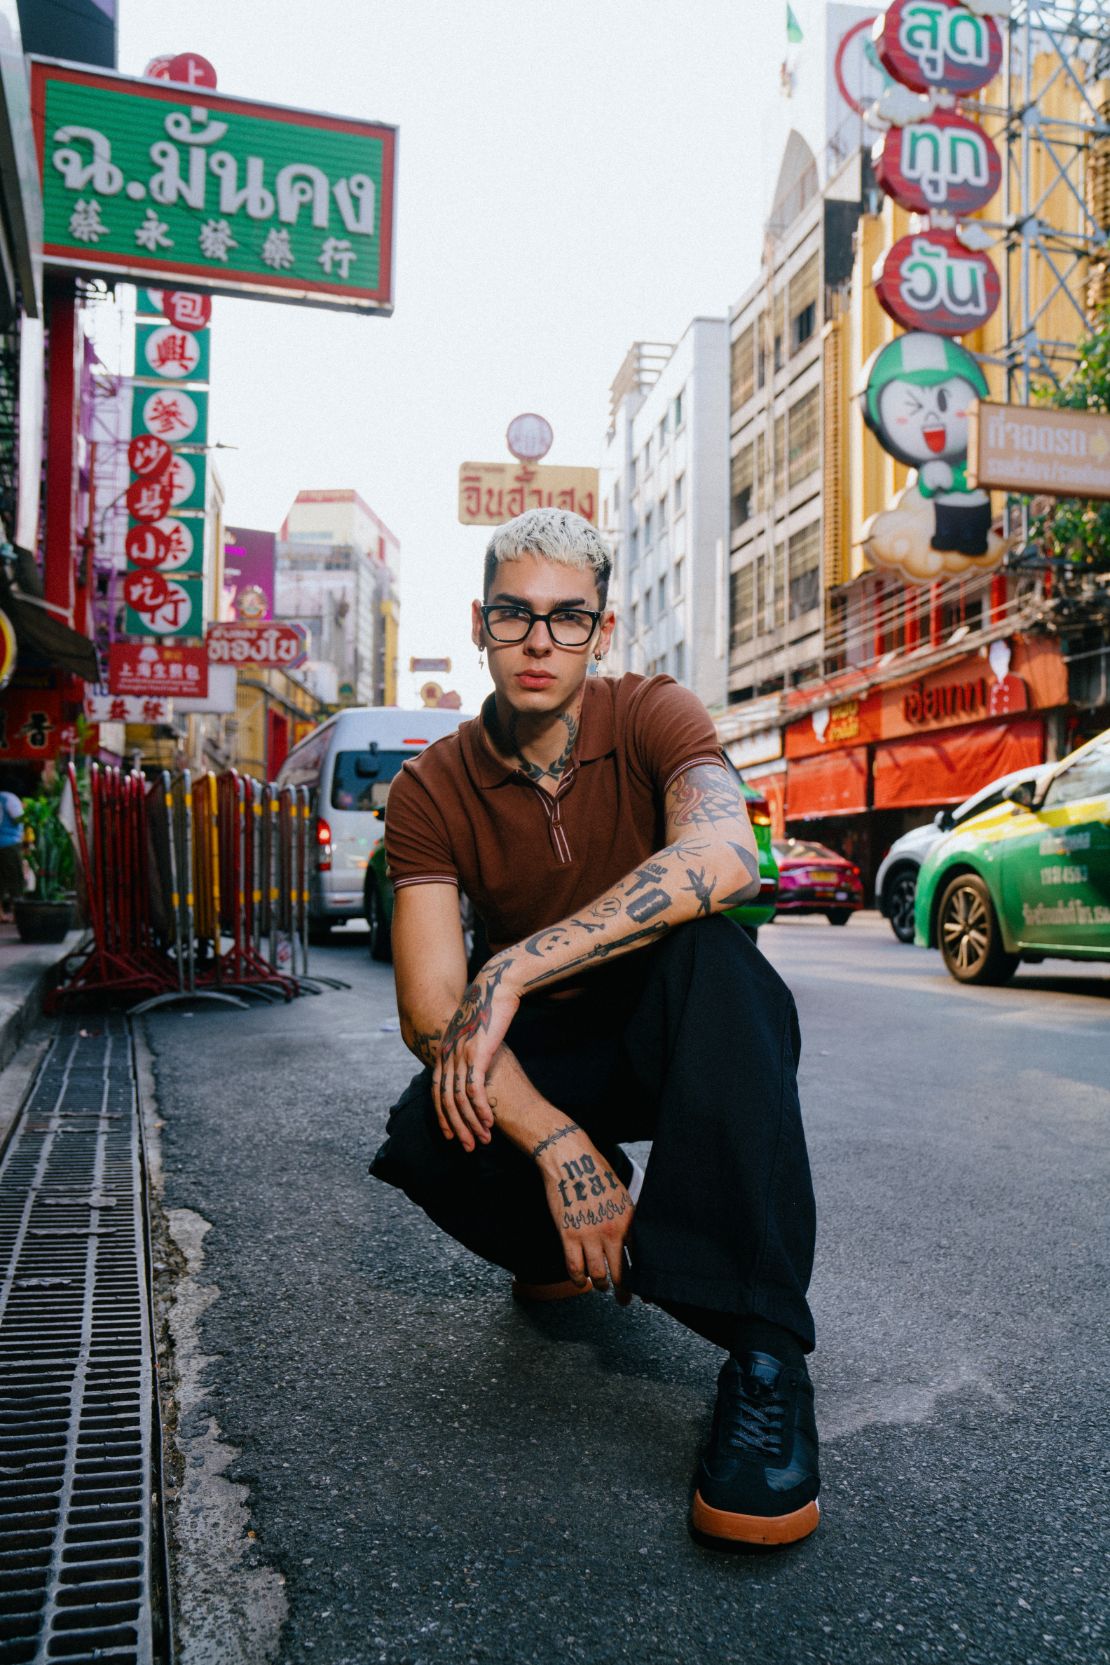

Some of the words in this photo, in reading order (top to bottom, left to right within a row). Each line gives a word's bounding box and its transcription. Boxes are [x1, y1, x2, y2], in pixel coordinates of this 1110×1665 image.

[902, 3, 990, 80] สุด
[52, 105, 376, 236] ฉ.มั่นคง
[901, 123, 989, 203] ทุก
[901, 238, 987, 315] วัน
